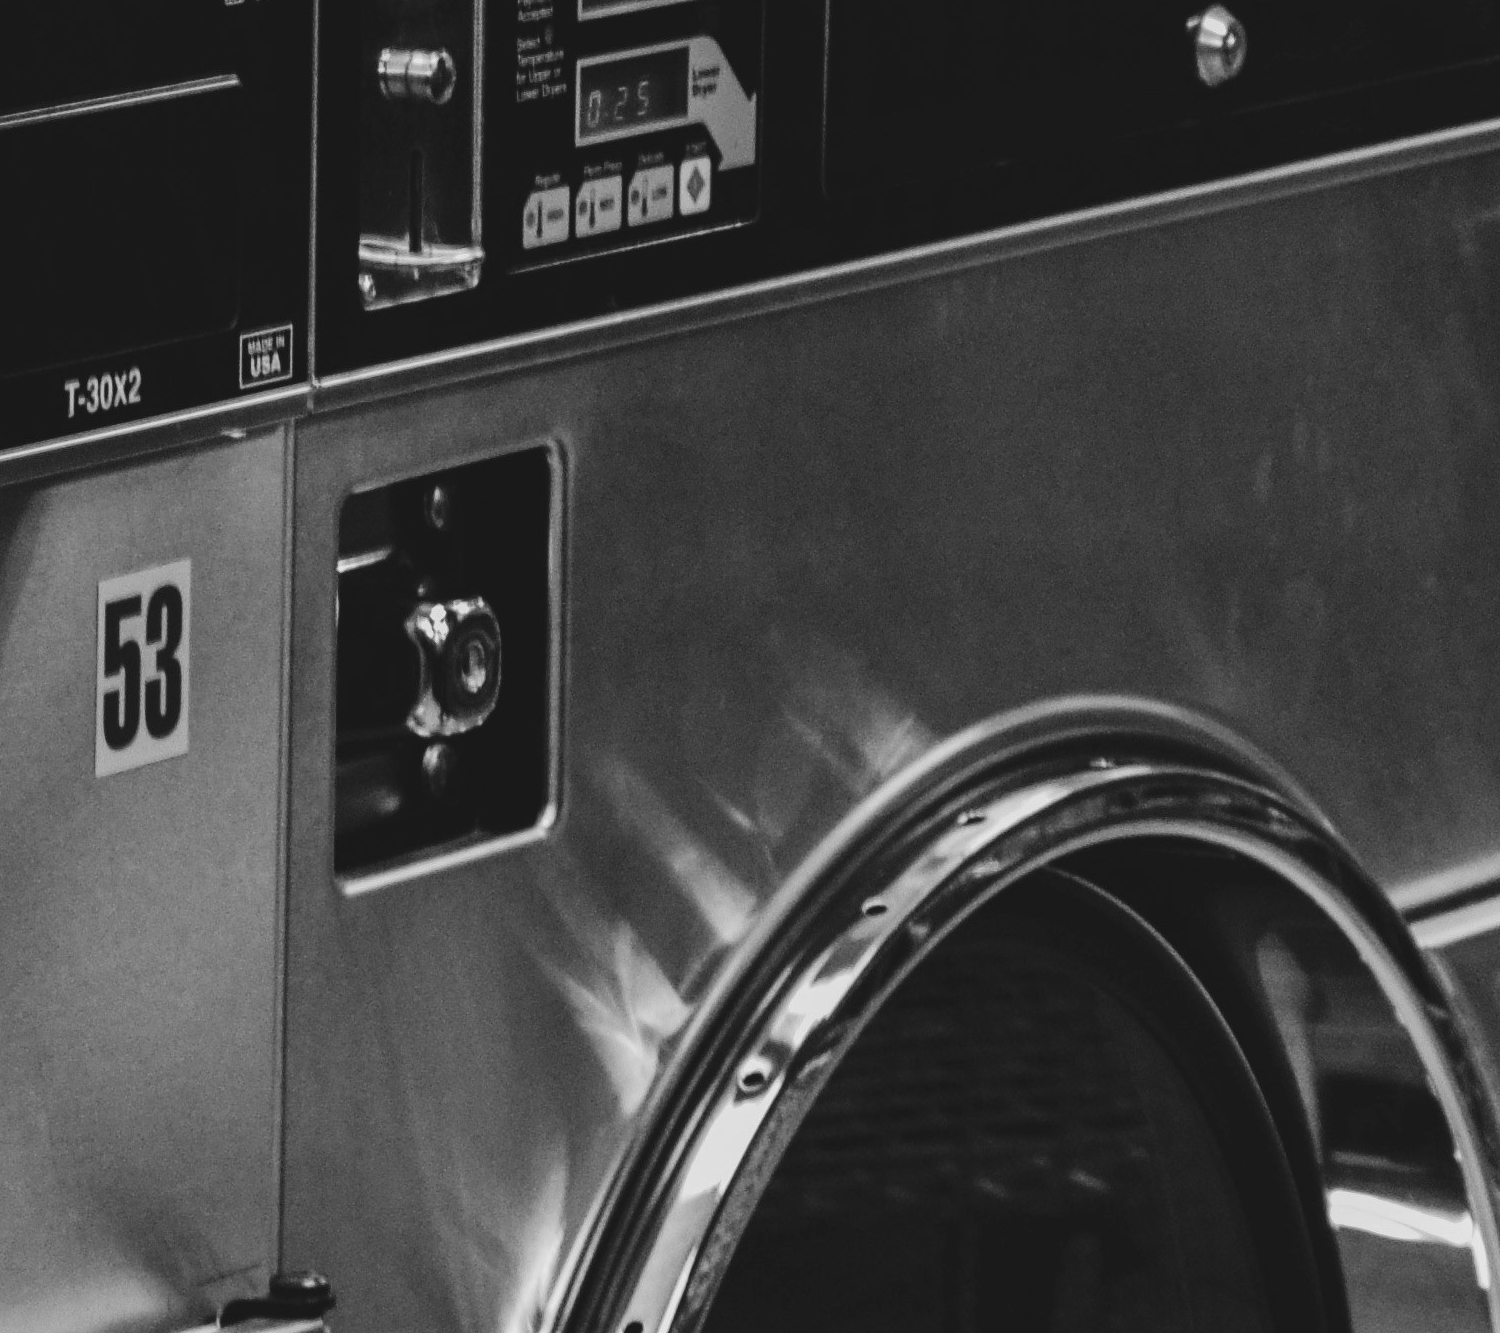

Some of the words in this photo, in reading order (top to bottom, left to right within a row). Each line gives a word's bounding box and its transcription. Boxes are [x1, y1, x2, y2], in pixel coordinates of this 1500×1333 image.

[248, 336, 273, 355] MADE
[251, 351, 281, 378] USA
[65, 365, 141, 418] T-30X2
[102, 583, 183, 751] 53
